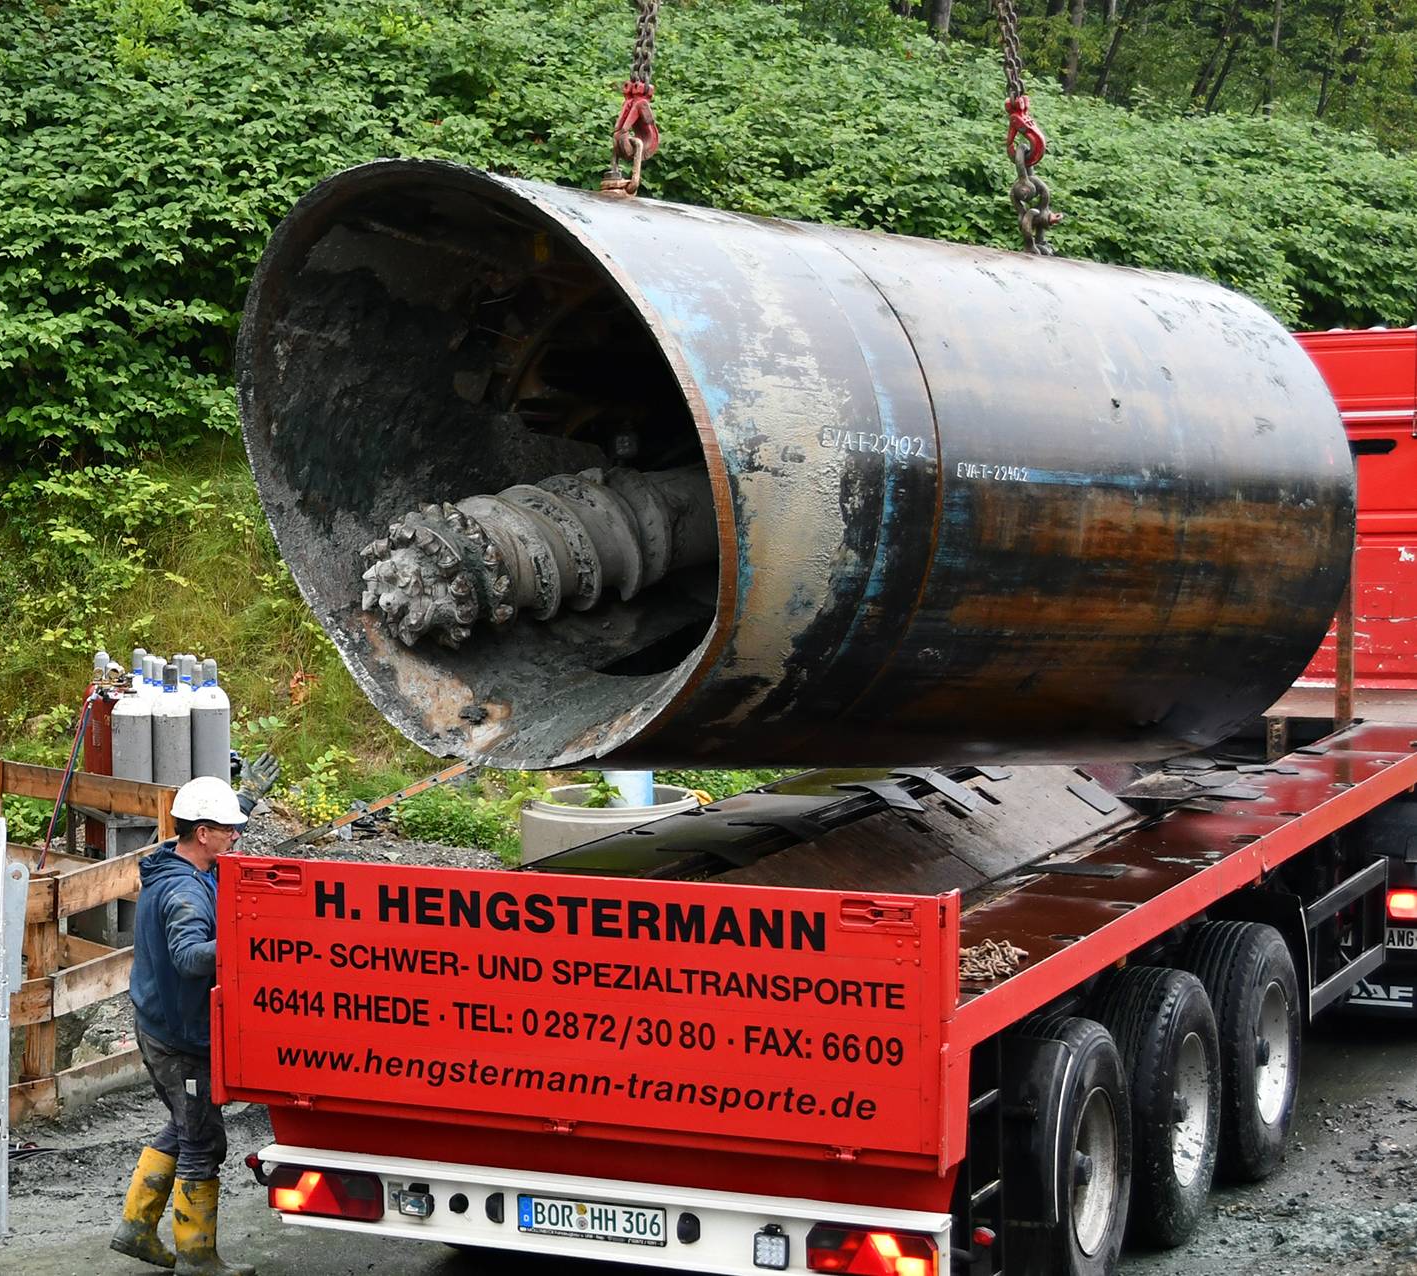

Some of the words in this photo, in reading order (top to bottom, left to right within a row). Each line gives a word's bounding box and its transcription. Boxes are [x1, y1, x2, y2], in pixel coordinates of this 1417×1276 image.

[315, 880, 361, 921] H.
[378, 884, 825, 951] HENGSTERMANN
[249, 937, 322, 964] KIPP-
[330, 943, 469, 976] SCHWER-
[478, 954, 543, 982] UND
[552, 959, 905, 1010] SPEZIALTRANSPORTE
[253, 986, 325, 1018] 46414
[333, 992, 430, 1027] RHEDE
[452, 1002, 513, 1034] TEL:
[744, 1025, 812, 1059] FAX:
[277, 1046, 877, 1120] www.hengstermann-transporte.de
[534, 1201, 573, 1228] BOR
[591, 1207, 616, 1232] HH
[622, 1210, 661, 1237] 306
